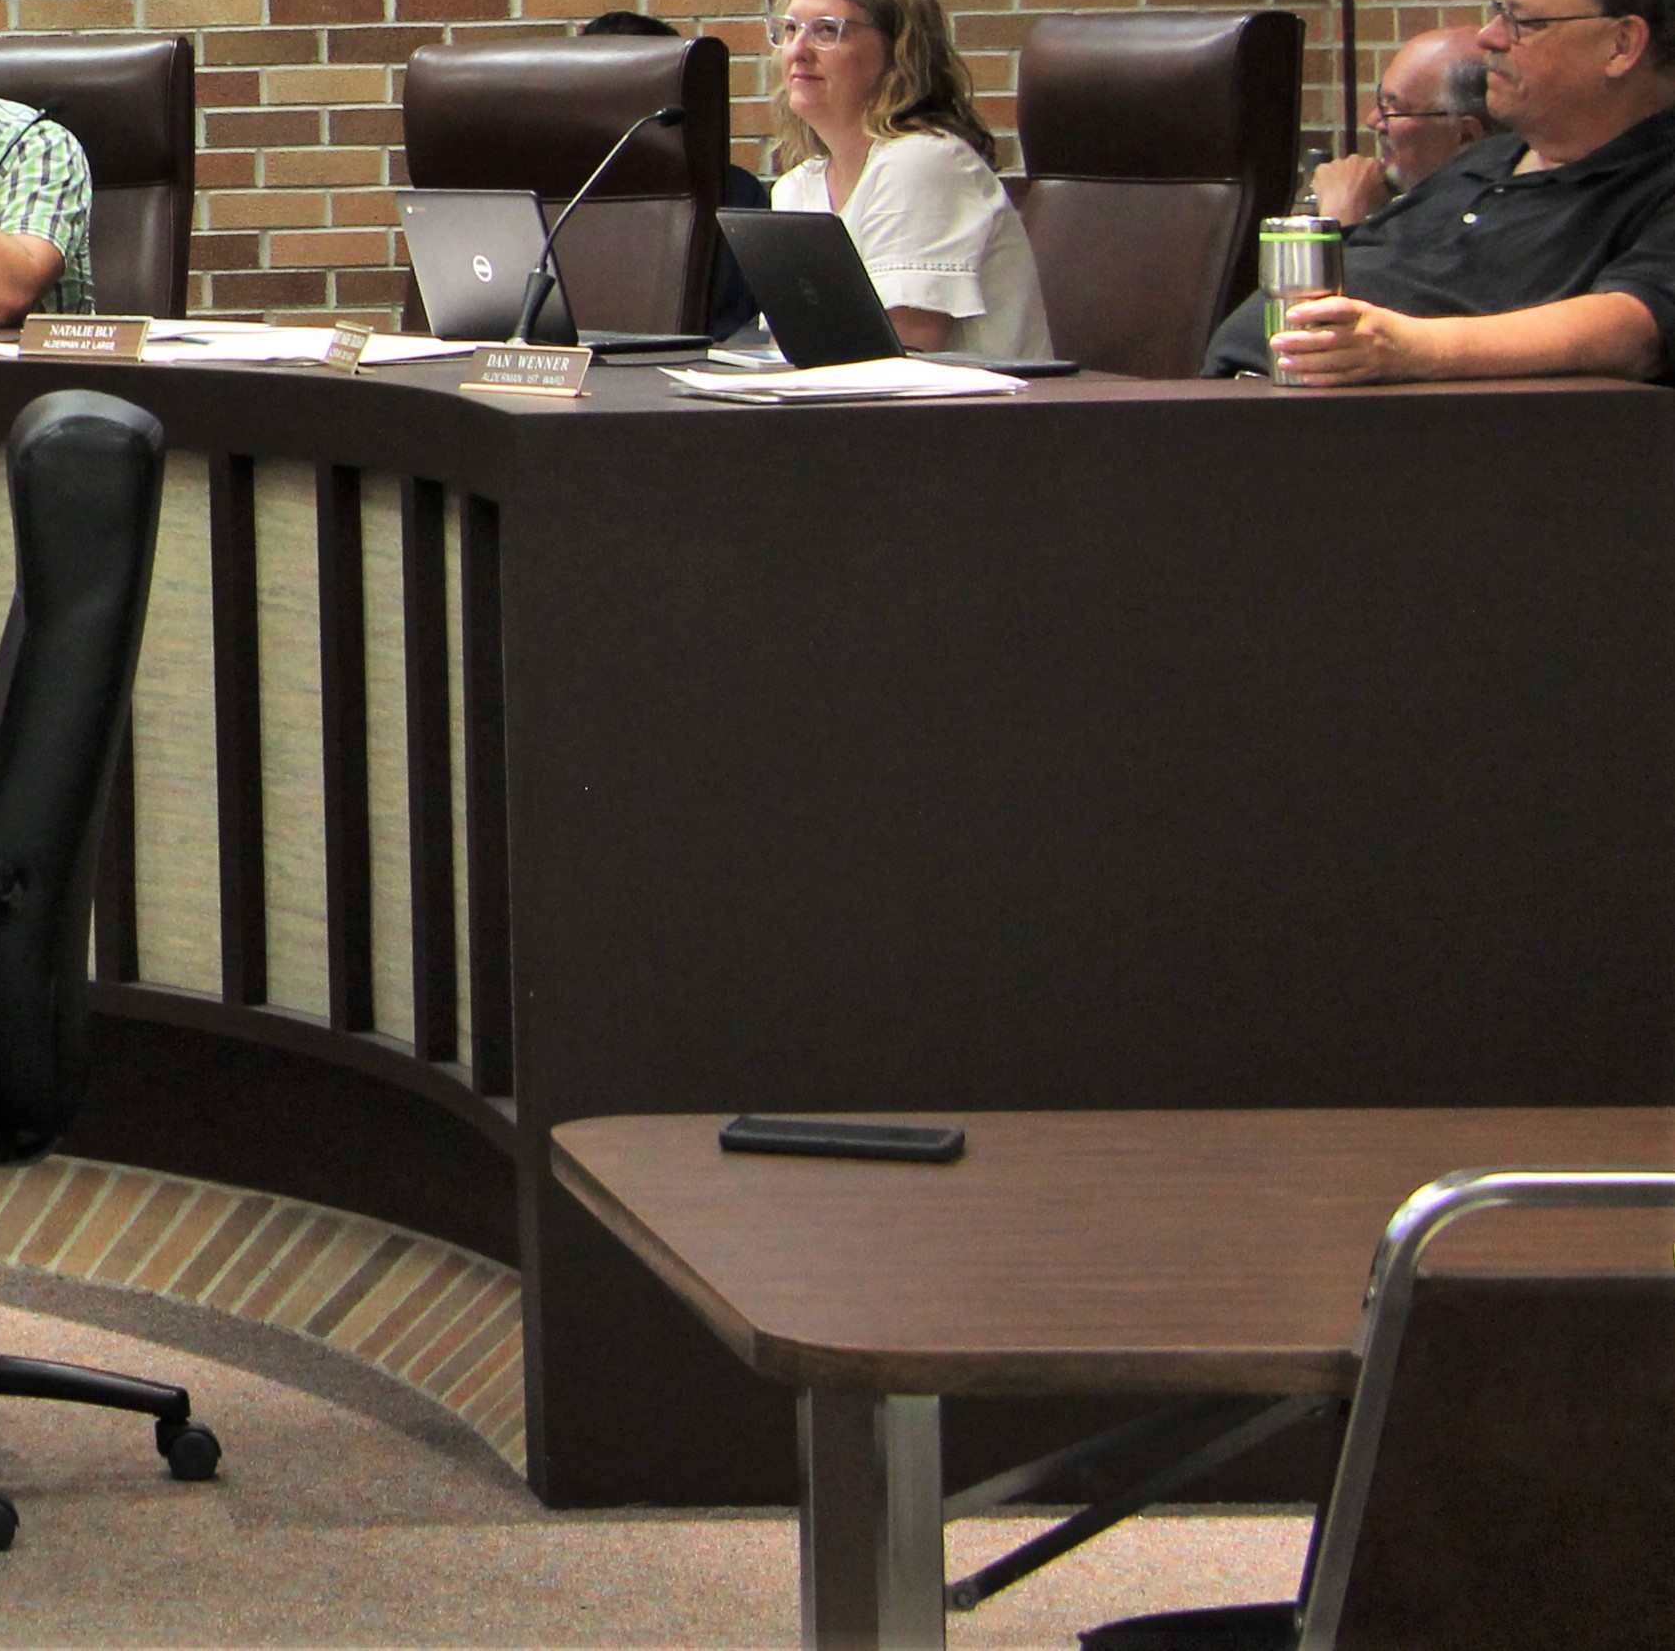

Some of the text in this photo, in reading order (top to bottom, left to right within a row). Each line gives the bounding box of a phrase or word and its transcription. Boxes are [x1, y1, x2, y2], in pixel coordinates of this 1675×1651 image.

[50, 324, 116, 338] NATALIE BLY
[487, 354, 570, 371] DAN WENNER
[481, 372, 522, 384] ALDERMAN
